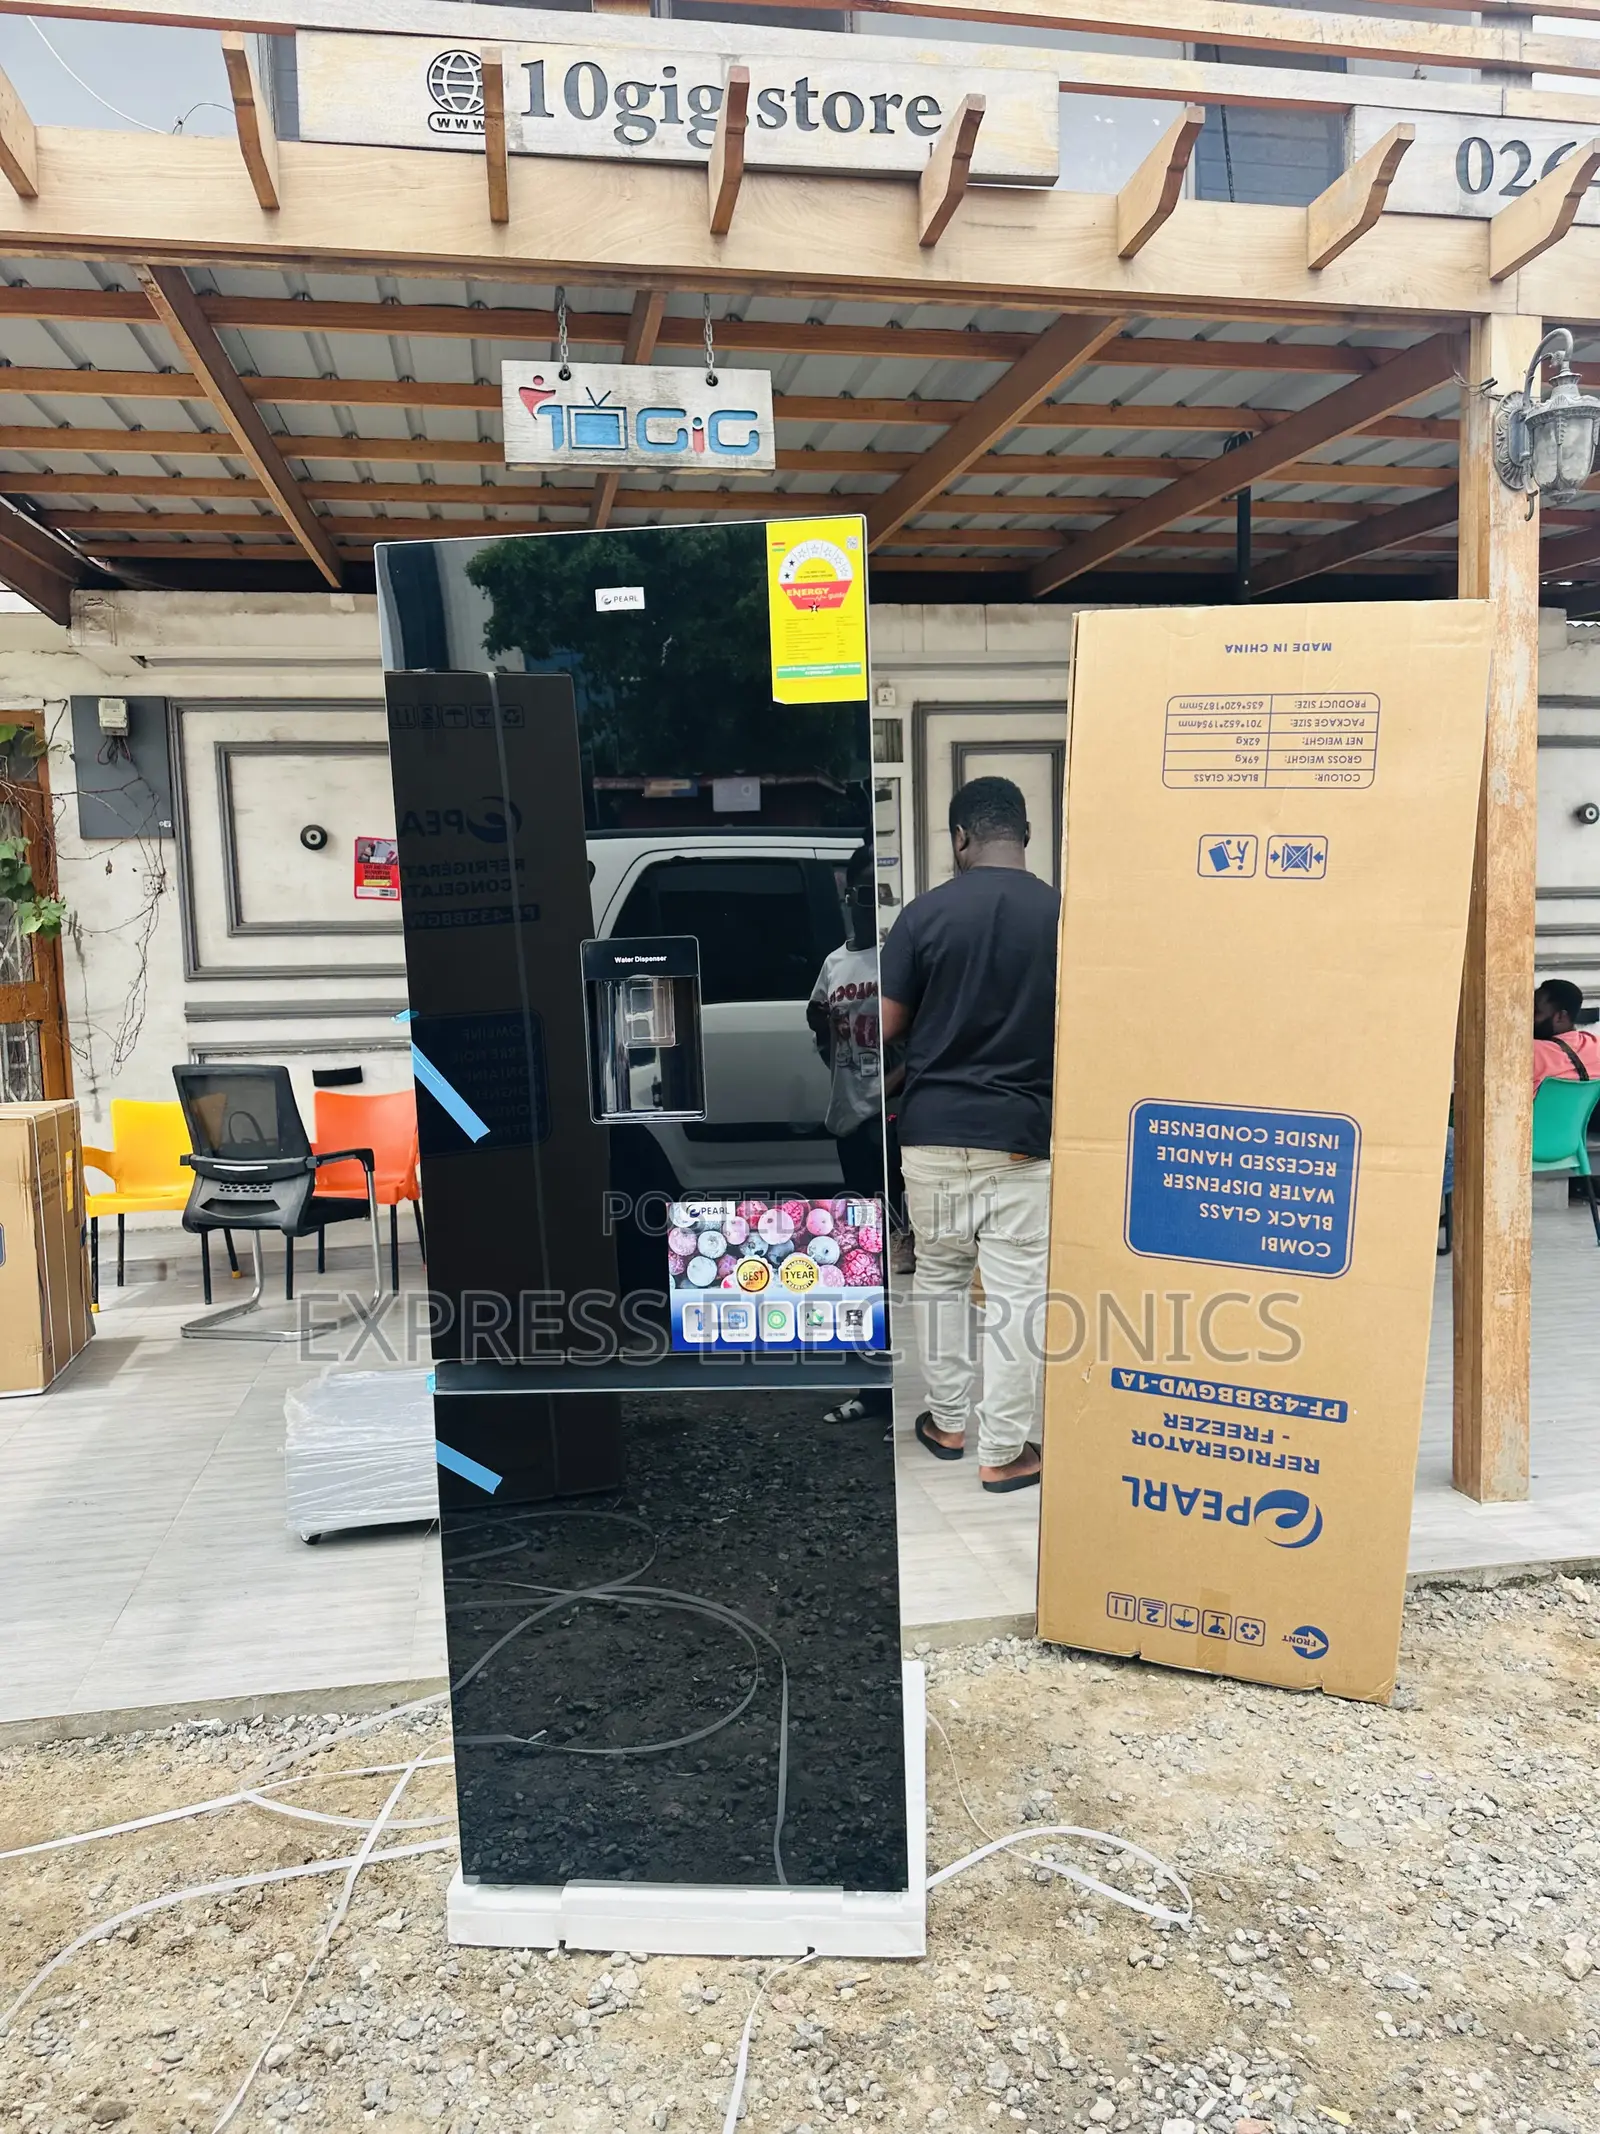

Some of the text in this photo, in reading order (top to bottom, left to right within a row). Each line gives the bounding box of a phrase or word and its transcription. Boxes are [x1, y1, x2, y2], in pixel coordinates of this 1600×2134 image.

[786, 587, 830, 599] ENERGY
[613, 595, 639, 603] PEARL
[1225, 642, 1332, 653] MADE IN CHINA
[1294, 700, 1316, 709] SIZE:
[1318, 699, 1367, 709] PRODUCT
[1290, 719, 1312, 728] SIZE:
[1314, 718, 1365, 727] PACKAGE
[1302, 737, 1342, 746] WEIGHT:
[1345, 737, 1364, 746] NET
[1284, 755, 1325, 764] WEIGHT:
[1327, 755, 1362, 764] GROSS
[1194, 773, 1361, 783] COLOUR: BLACK GLASS
[614, 955, 667, 965] Water Dispenser
[1148, 1118, 1340, 1150] INSIDE CONDENSER
[1157, 1146, 1337, 1177] RECESSED HANDLE
[1163, 1173, 1335, 1204] WATER DISPENSER
[700, 1206, 730, 1216] PEARL
[1199, 1203, 1333, 1231] BLACK GLASS
[1261, 1236, 1331, 1258] COMBI
[742, 1270, 764, 1282] BEST
[790, 1270, 815, 1279] YEAR
[1119, 1371, 1340, 1419] PF-433BBGWD-1A
[1163, 1412, 1274, 1445] FREEZER
[1131, 1429, 1320, 1475] REFRIGERATOR
[1122, 1475, 1252, 1527] PEARL
[1282, 1634, 1317, 1648] FRONT
